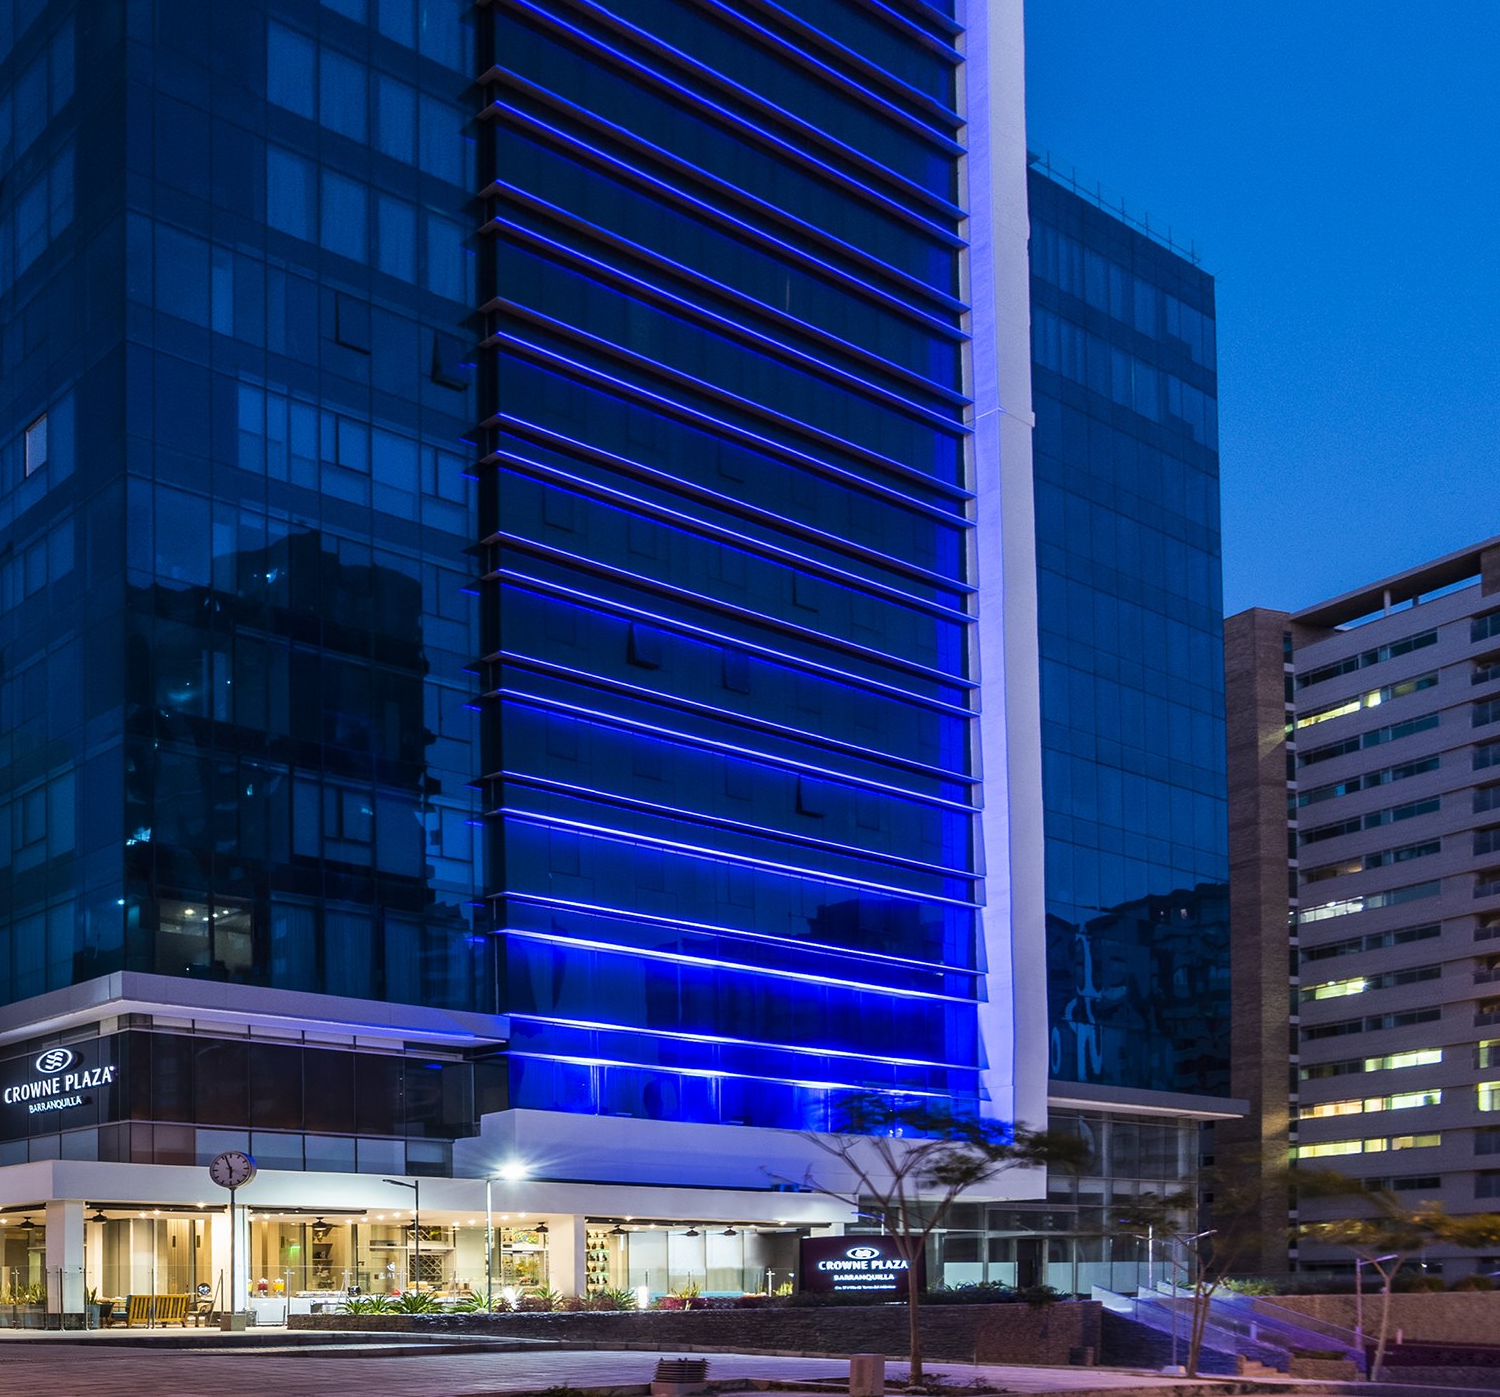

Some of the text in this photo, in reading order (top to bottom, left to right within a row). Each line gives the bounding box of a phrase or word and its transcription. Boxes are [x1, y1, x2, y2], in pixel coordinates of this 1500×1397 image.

[4, 1066, 113, 1104] CROWNE PLAZA
[28, 1095, 82, 1114] BARRANQUILLA
[818, 1260, 909, 1271] CROWNE PLAZA
[833, 1273, 895, 1282] BARRANQUILLA
